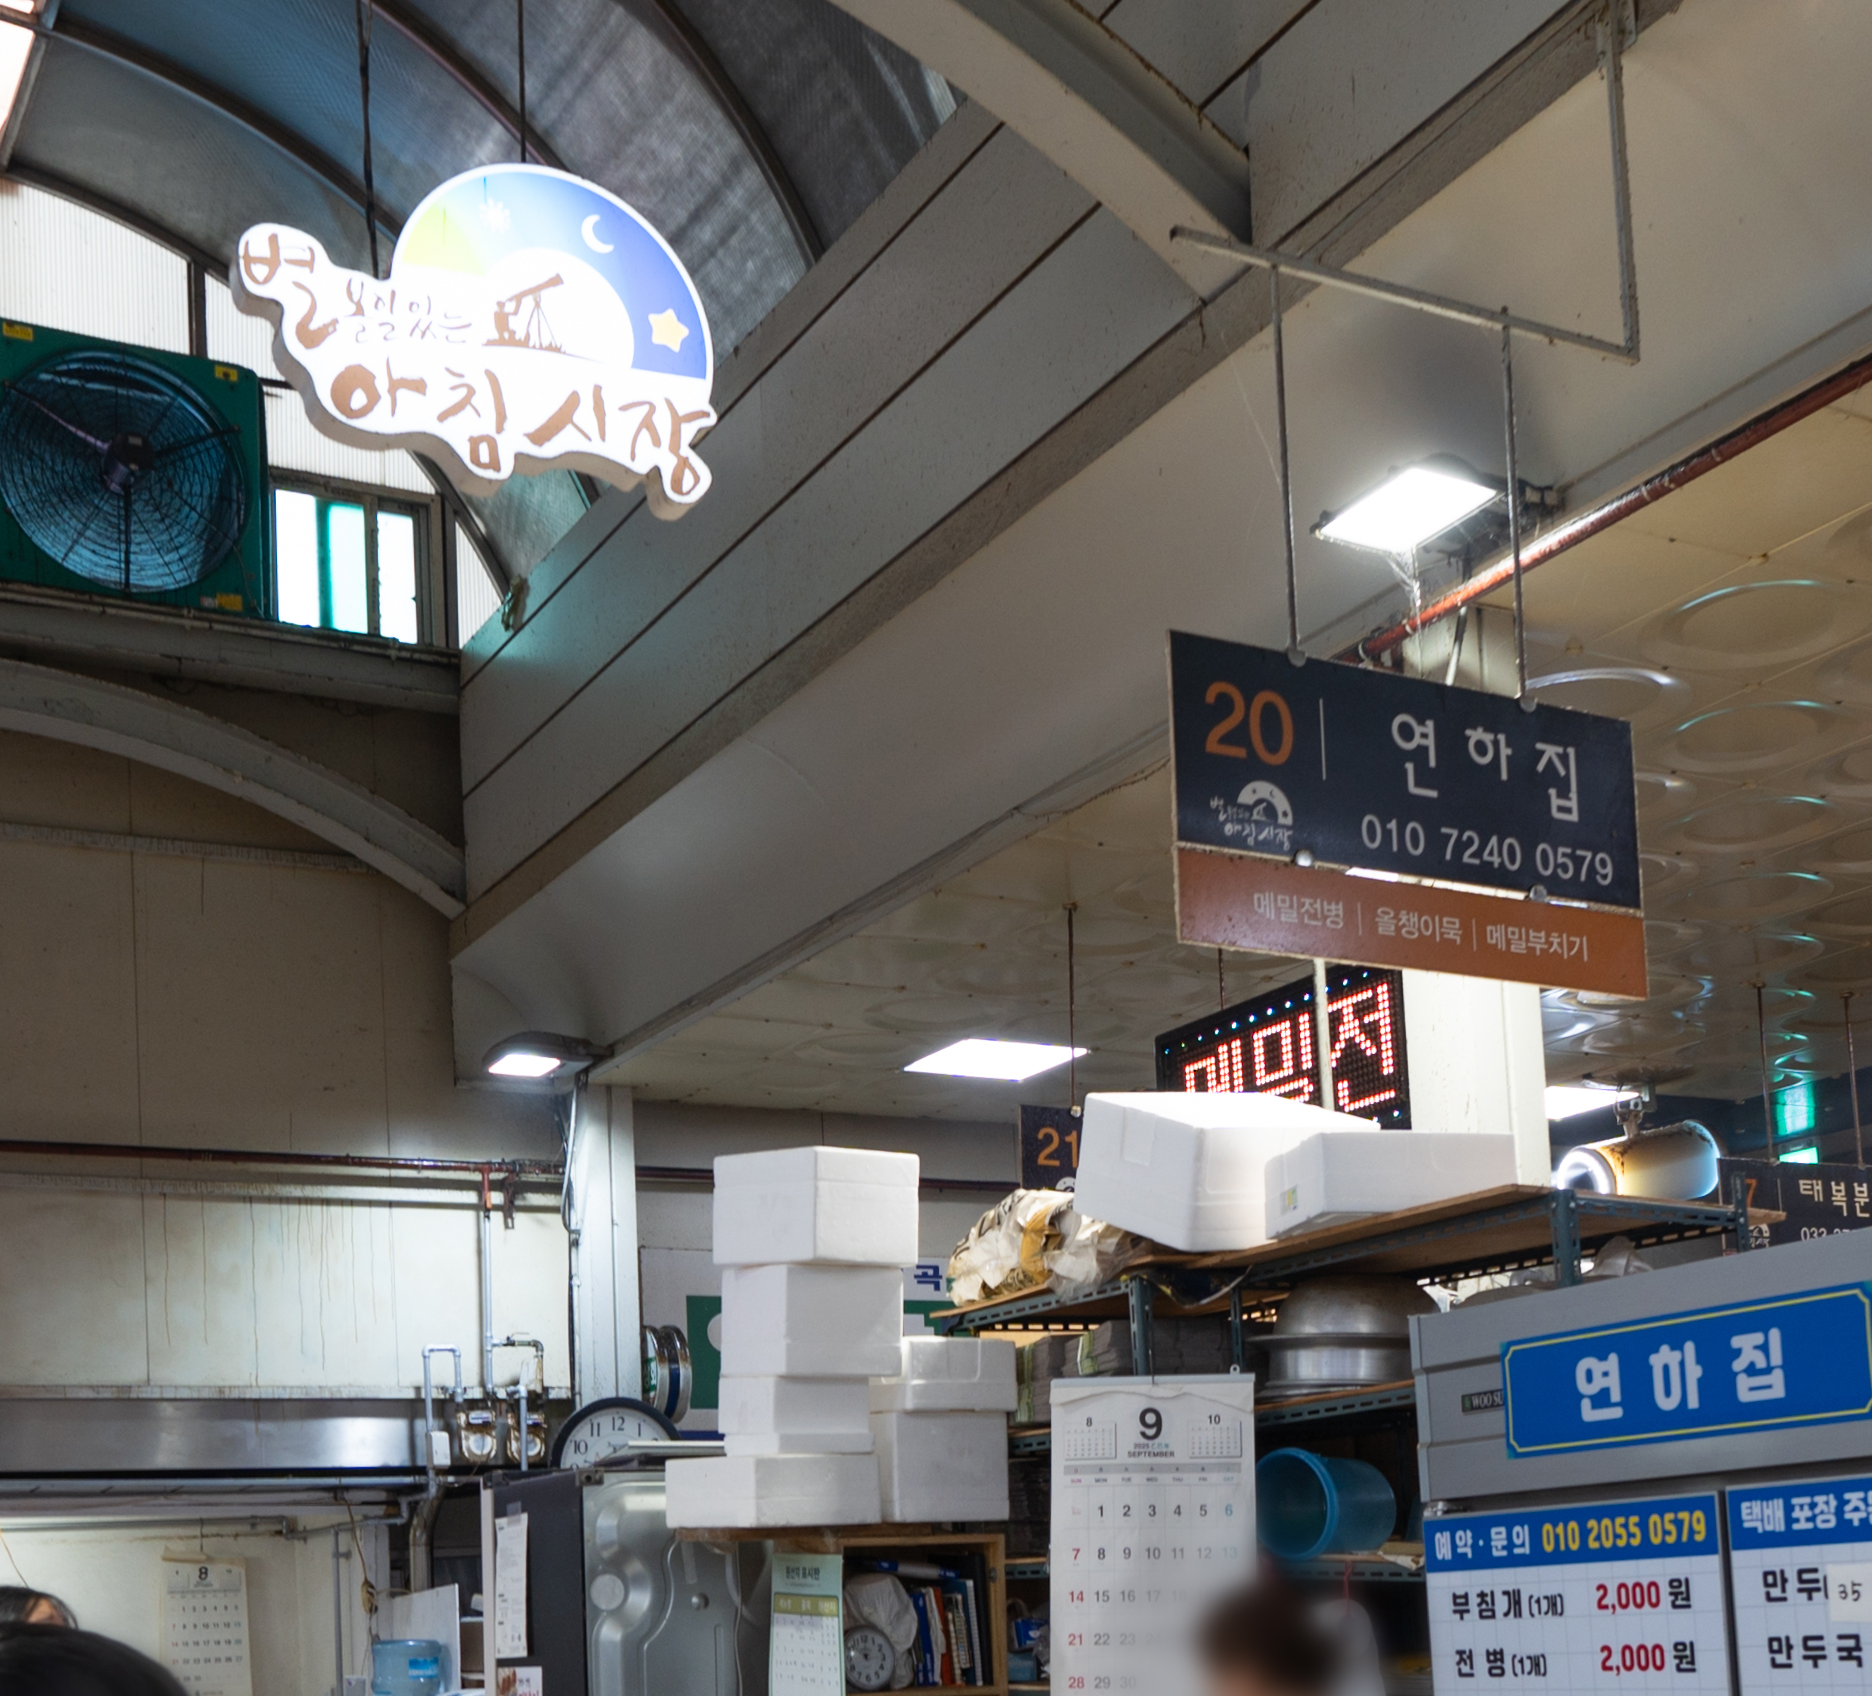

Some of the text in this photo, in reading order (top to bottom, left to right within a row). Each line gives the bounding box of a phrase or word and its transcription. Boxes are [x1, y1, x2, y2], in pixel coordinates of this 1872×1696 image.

[243, 232, 339, 350] 별
[1204, 680, 1295, 767] 20
[1390, 712, 1581, 825] 연하집
[1360, 813, 1615, 887] 010 7240 0579
[1252, 890, 1590, 964] 메밀전병 올챙이묵 메밀부치기
[1036, 1126, 1080, 1170] 21
[1574, 1326, 1787, 1423] 연하집
[611, 1415, 626, 1432] 12
[1138, 1407, 1163, 1441] 9
[1207, 1414, 1222, 1426] 10
[573, 1438, 588, 1456] 10
[1127, 1450, 1176, 1459] SEPTEMBER
[1097, 1505, 1233, 1518] 1 2 3 4 5 6
[1740, 1498, 1785, 1534] 택배
[1791, 1494, 1838, 1531] 포장
[1541, 1520, 1580, 1553] 010
[1586, 1515, 1642, 1550] 2055
[1648, 1509, 1707, 1545] 0579
[1072, 1548, 1080, 1560] 7
[1097, 1548, 1106, 1560] 8
[1123, 1548, 1131, 1560] 9
[1145, 1548, 1161, 1560] 10
[1068, 1590, 1084, 1603] 14
[1094, 1590, 1110, 1603] 15
[1119, 1590, 1136, 1603] 16
[1451, 1588, 1524, 1621] 부침개
[1595, 1580, 1662, 1615] 2,000
[1667, 1576, 1692, 1610] 원
[1068, 1633, 1084, 1646] 21
[1094, 1633, 1111, 1646] 22
[1767, 1632, 1863, 1669] 만두국
[1455, 1647, 1506, 1678] 전병
[1599, 1643, 1666, 1677] 2,000
[1672, 1640, 1697, 1674] 원
[1068, 1676, 1085, 1689] 28
[1094, 1676, 1111, 1689] 29
